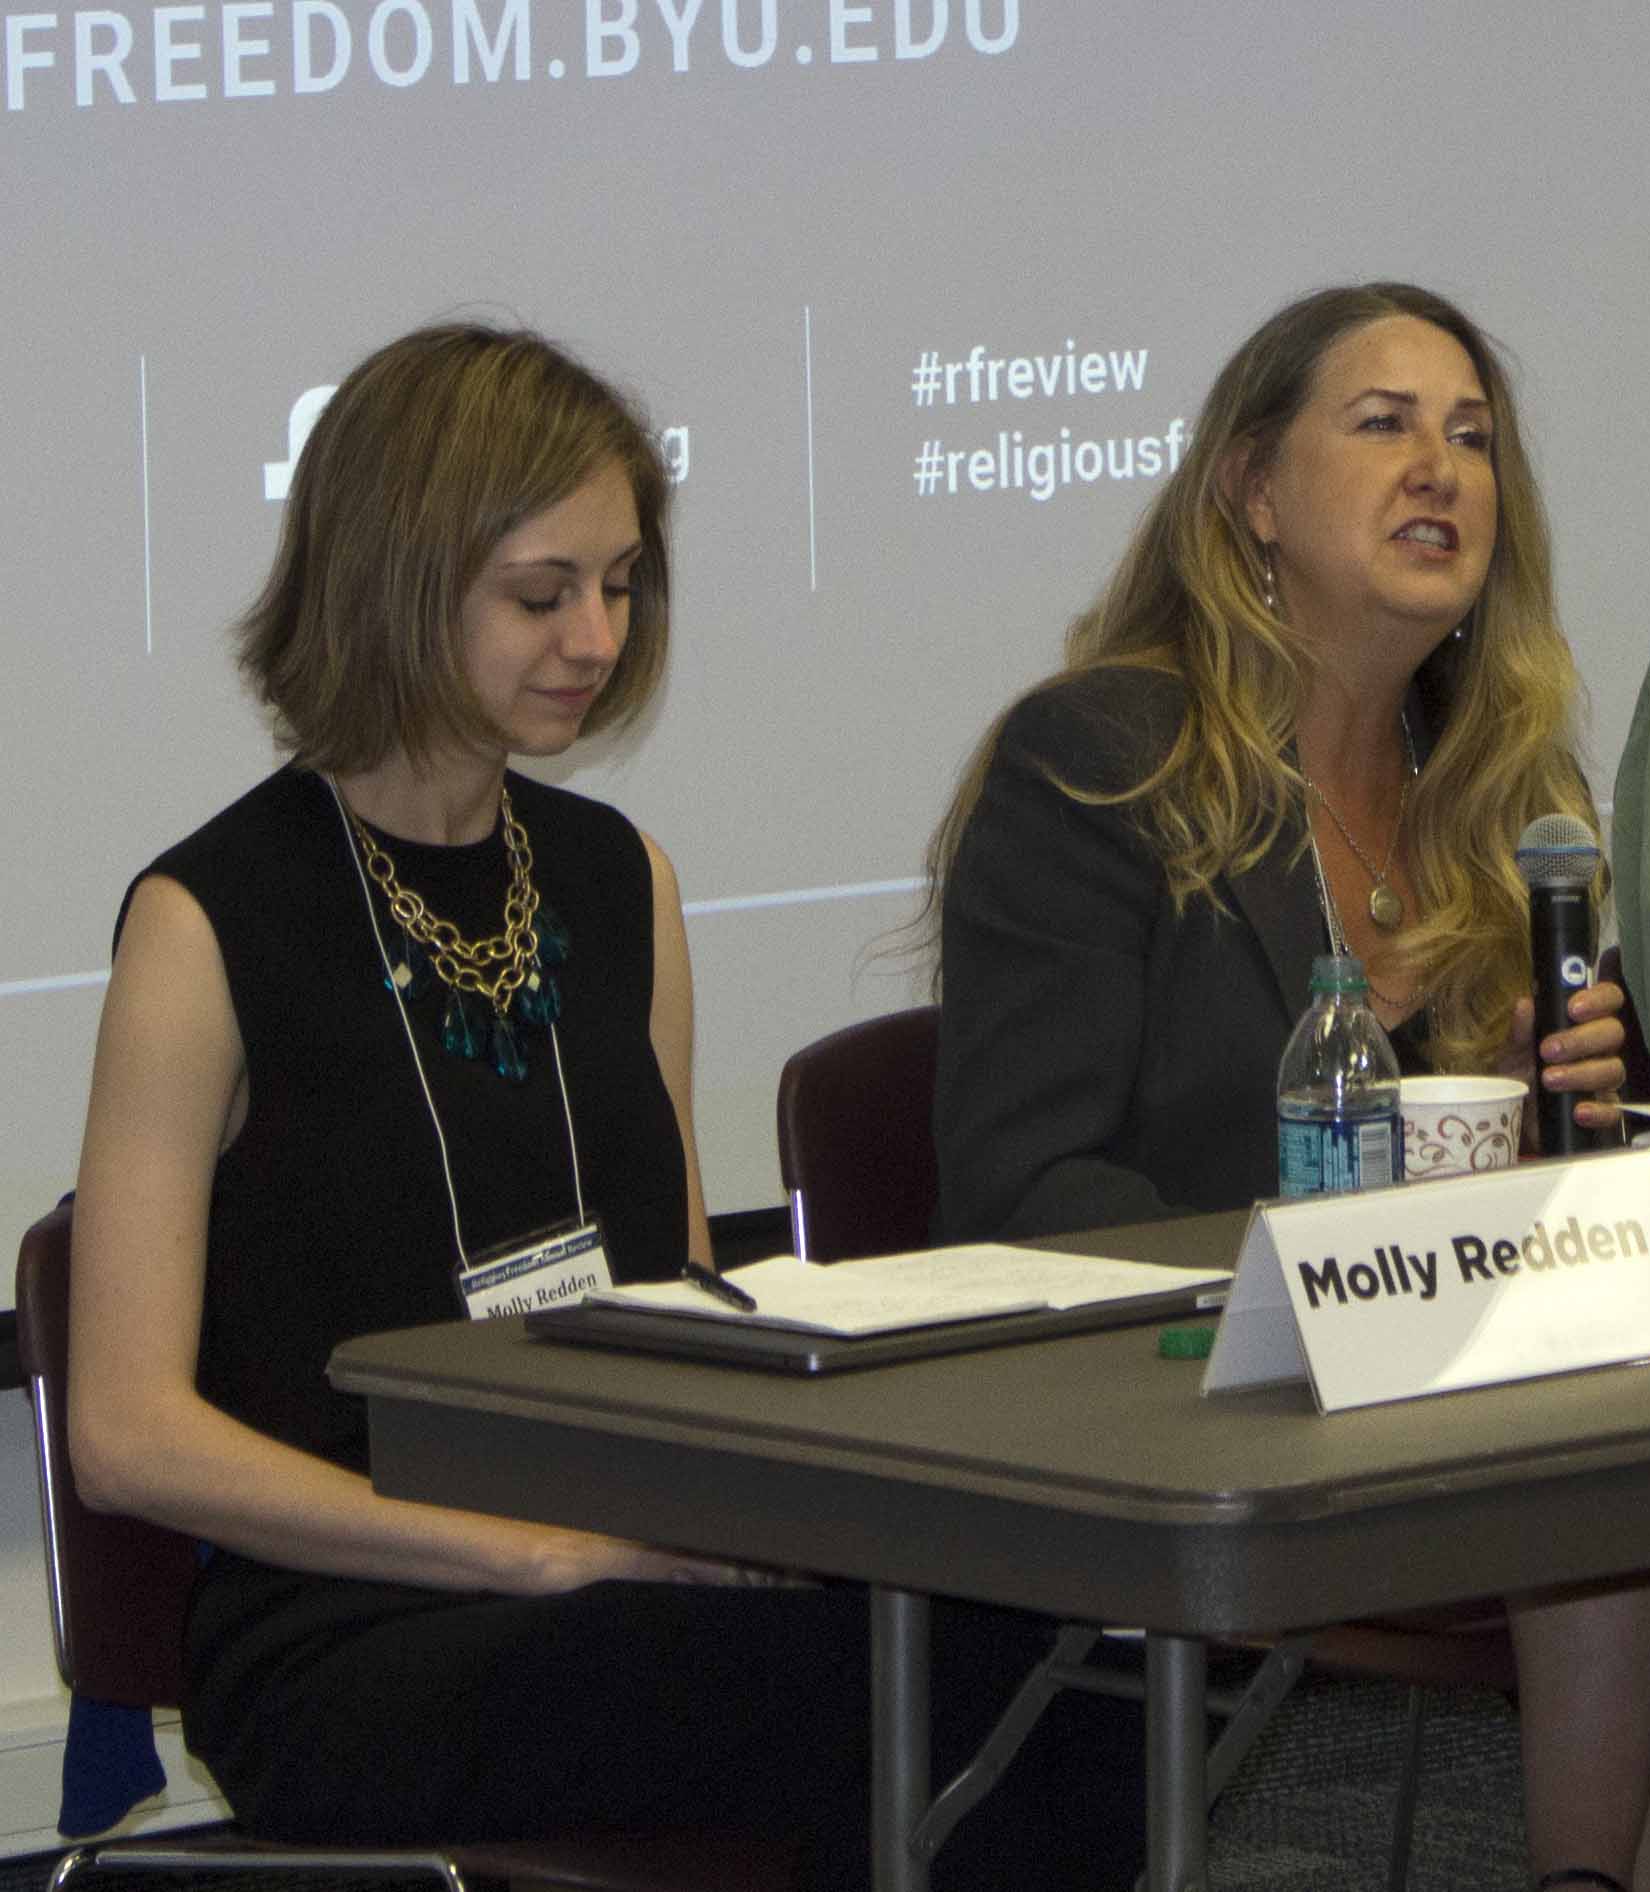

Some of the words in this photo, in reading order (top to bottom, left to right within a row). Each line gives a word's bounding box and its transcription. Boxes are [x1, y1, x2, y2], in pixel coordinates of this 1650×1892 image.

[5, 0, 1019, 111] FREEDOM.BYU.EDU
[911, 338, 1149, 407] #rfreview
[487, 1296, 532, 1319] Molly
[536, 1273, 598, 1305] Redden
[1298, 1245, 1437, 1308] Molly
[1451, 1216, 1649, 1283] Redden
